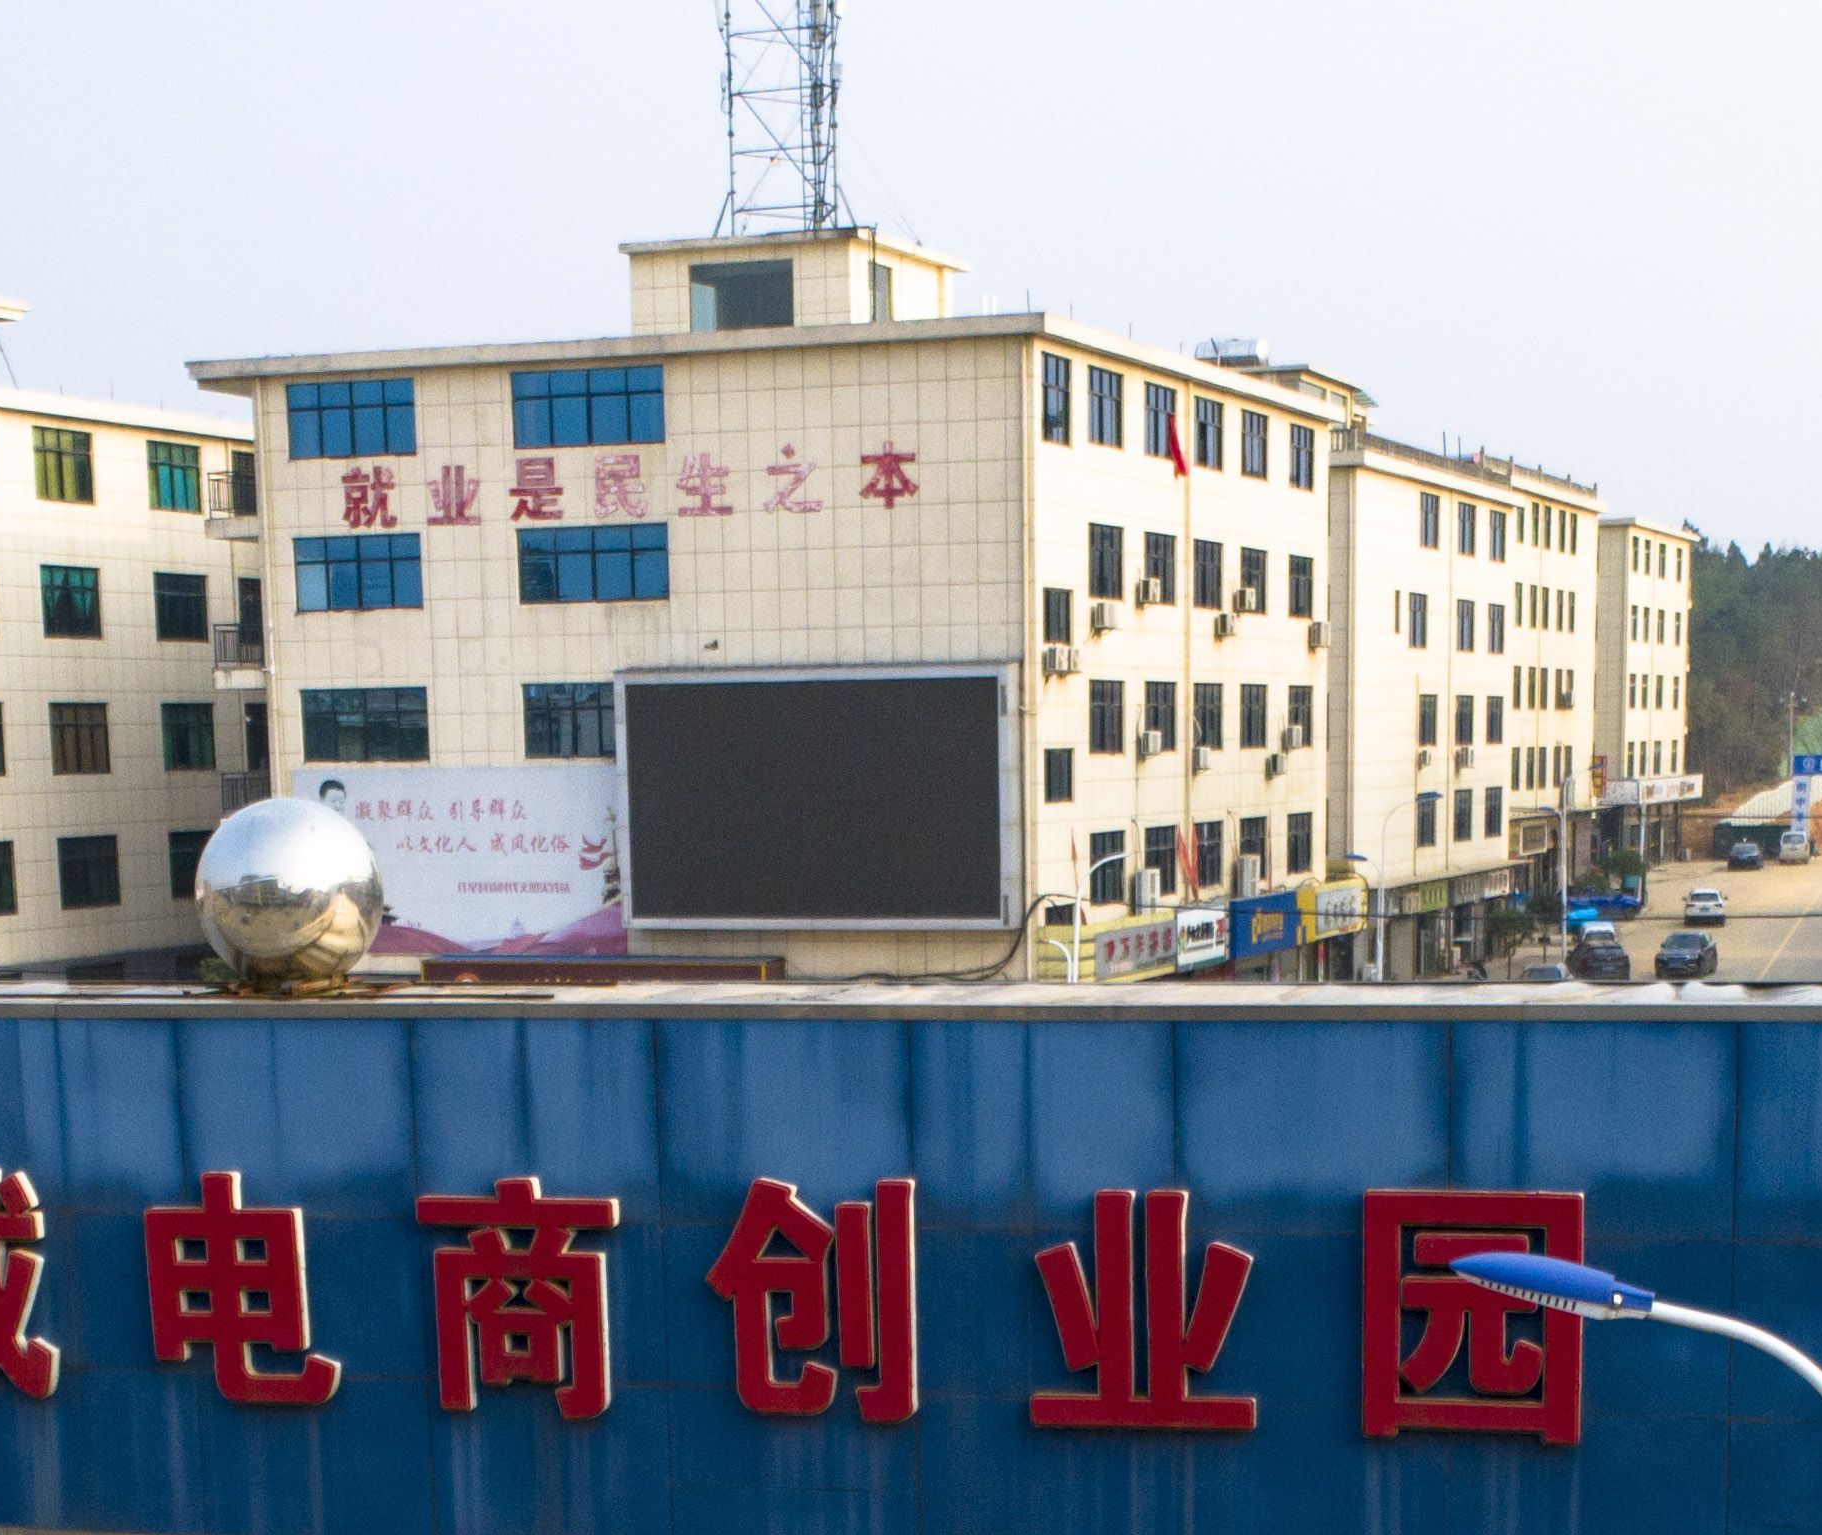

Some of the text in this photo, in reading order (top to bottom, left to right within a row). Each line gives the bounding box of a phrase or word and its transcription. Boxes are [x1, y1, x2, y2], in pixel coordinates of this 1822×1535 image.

[341, 441, 920, 530] 就业是民生之本
[355, 798, 527, 821] 凝聚群众 引导群众
[396, 832, 570, 855] 以文化人 成风化俗
